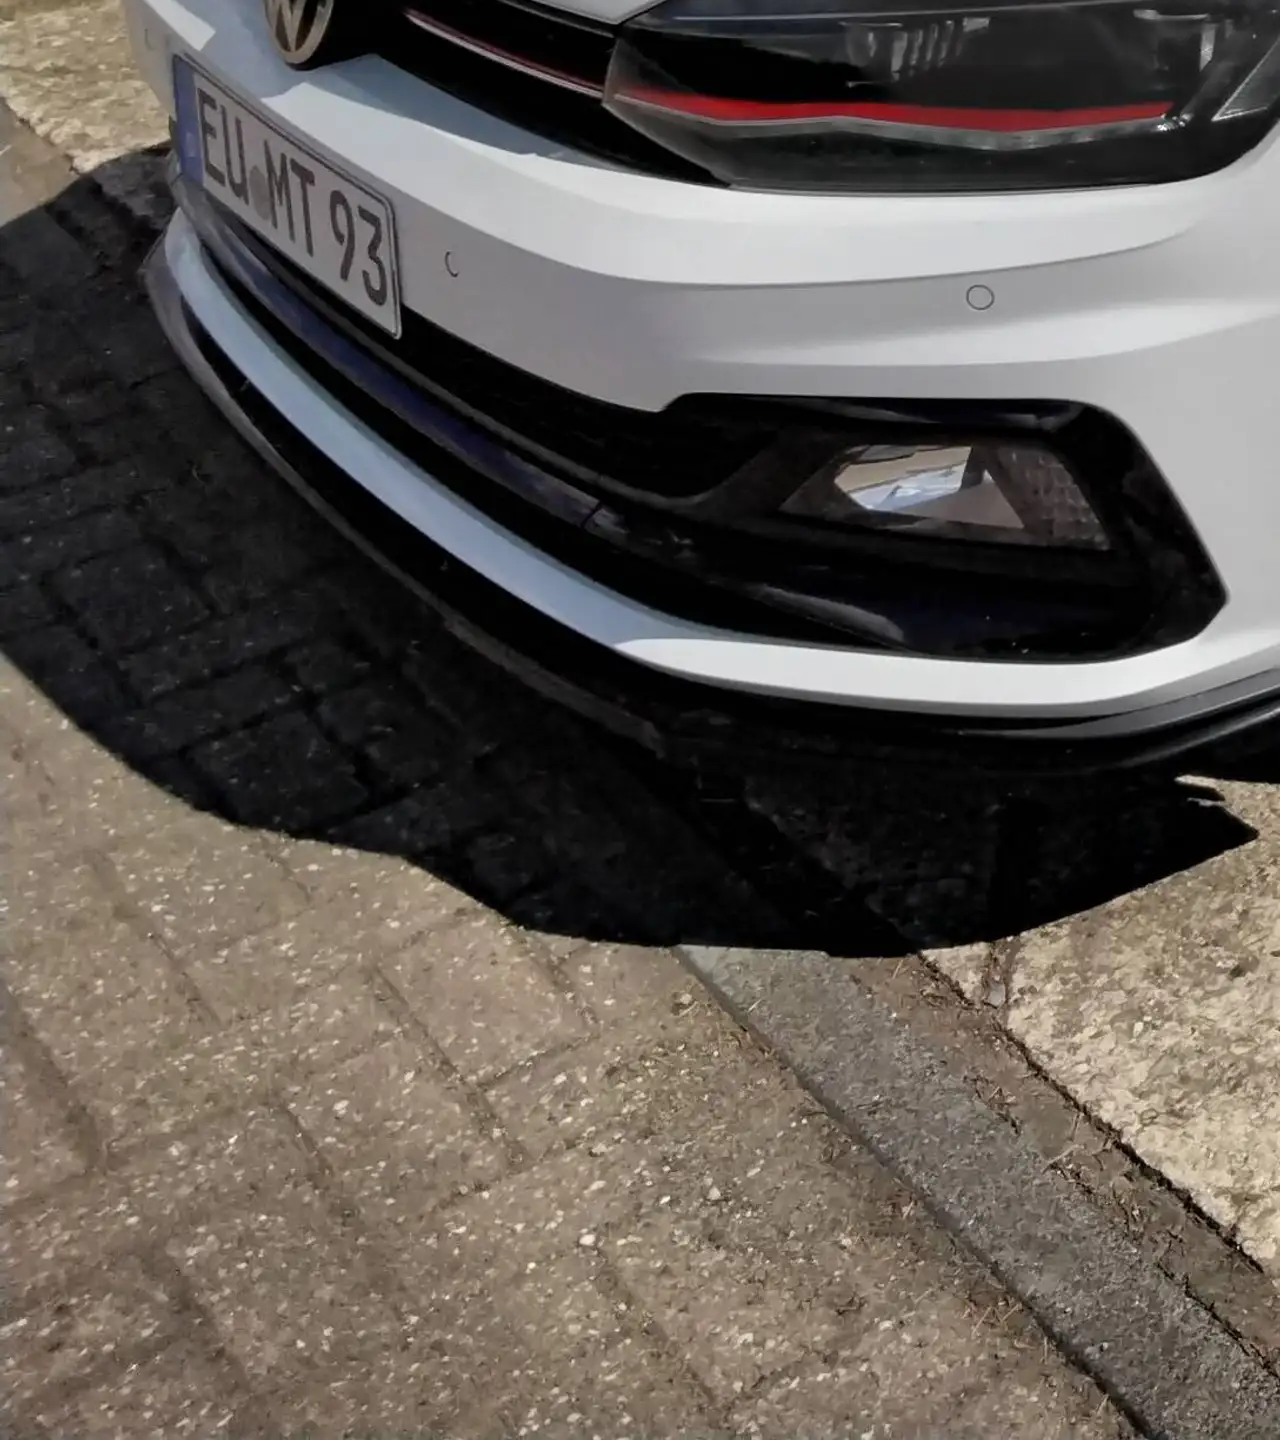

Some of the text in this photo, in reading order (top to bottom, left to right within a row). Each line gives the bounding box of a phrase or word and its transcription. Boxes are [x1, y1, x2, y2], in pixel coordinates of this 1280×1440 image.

[197, 87, 388, 307] EU MT 93
